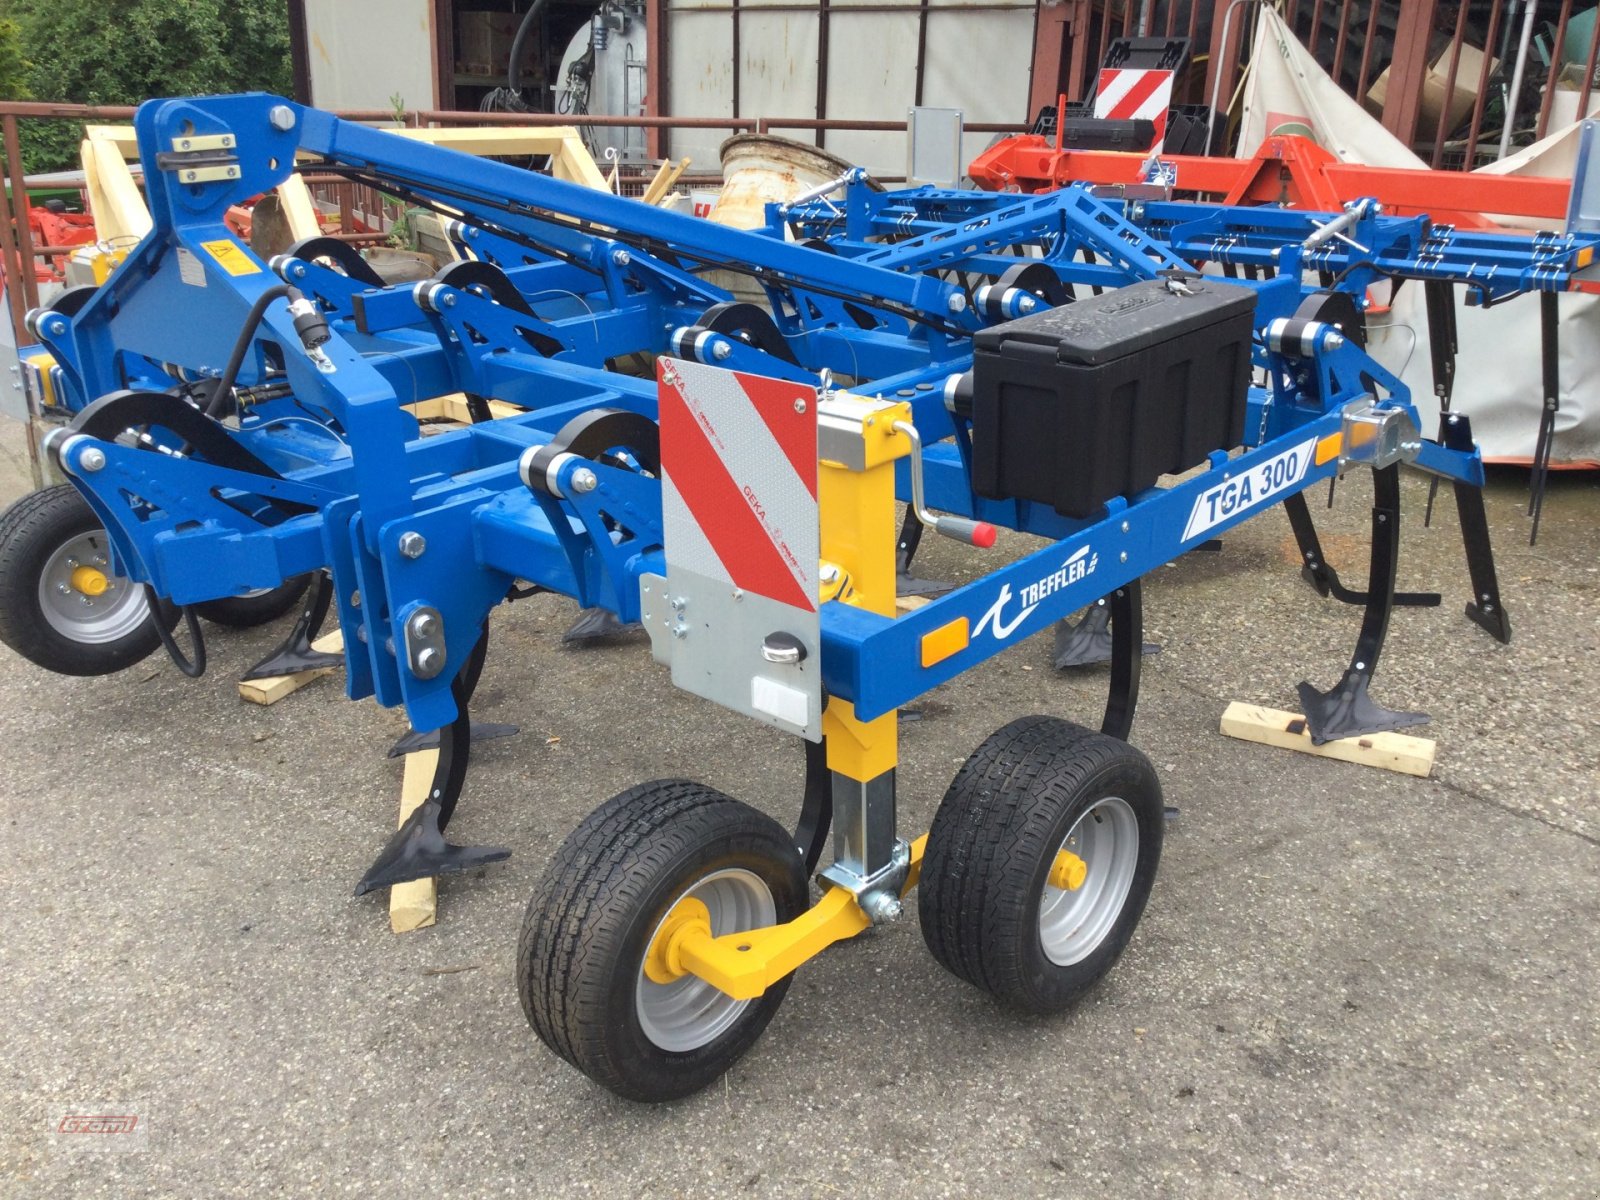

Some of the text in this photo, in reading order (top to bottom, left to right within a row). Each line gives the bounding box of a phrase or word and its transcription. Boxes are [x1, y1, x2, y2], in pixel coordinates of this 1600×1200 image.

[743, 485, 766, 520] GEKA
[1206, 452, 1298, 523] TGA 300
[1020, 559, 1086, 608] TREFFLER
